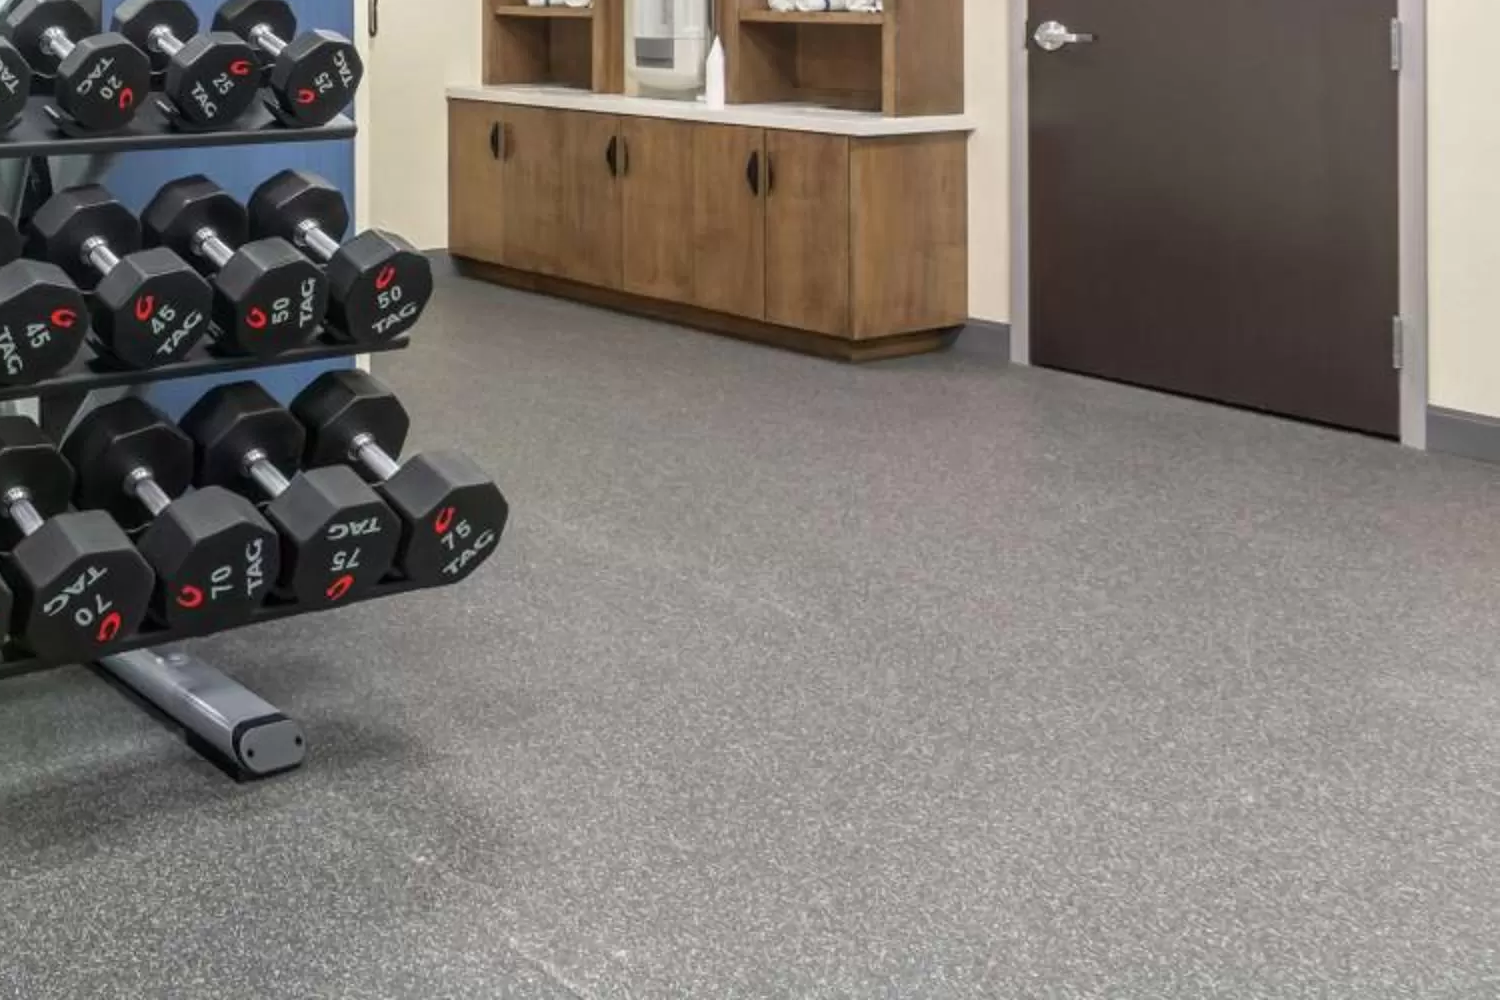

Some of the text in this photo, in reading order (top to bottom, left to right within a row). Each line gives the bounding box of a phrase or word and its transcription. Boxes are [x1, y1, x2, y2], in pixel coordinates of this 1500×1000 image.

[76, 56, 115, 95] TAG
[212, 73, 234, 94] 25
[315, 72, 333, 93] 25
[334, 50, 353, 88] TAG
[100, 75, 122, 99] 20
[191, 81, 218, 118] TAG
[272, 298, 289, 324] 50
[300, 278, 315, 327] TAG
[378, 286, 401, 308] 50
[151, 305, 176, 335] 45
[156, 310, 202, 355] TAG
[371, 302, 417, 334] TAG
[27, 324, 50, 348] 45
[326, 516, 382, 540] TAG
[441, 520, 471, 549] 75
[246, 539, 263, 595] TAG
[331, 548, 360, 571] 75
[442, 529, 495, 576] TAG
[43, 565, 108, 617] TAG
[212, 566, 232, 599] 70
[74, 594, 113, 626] 70
